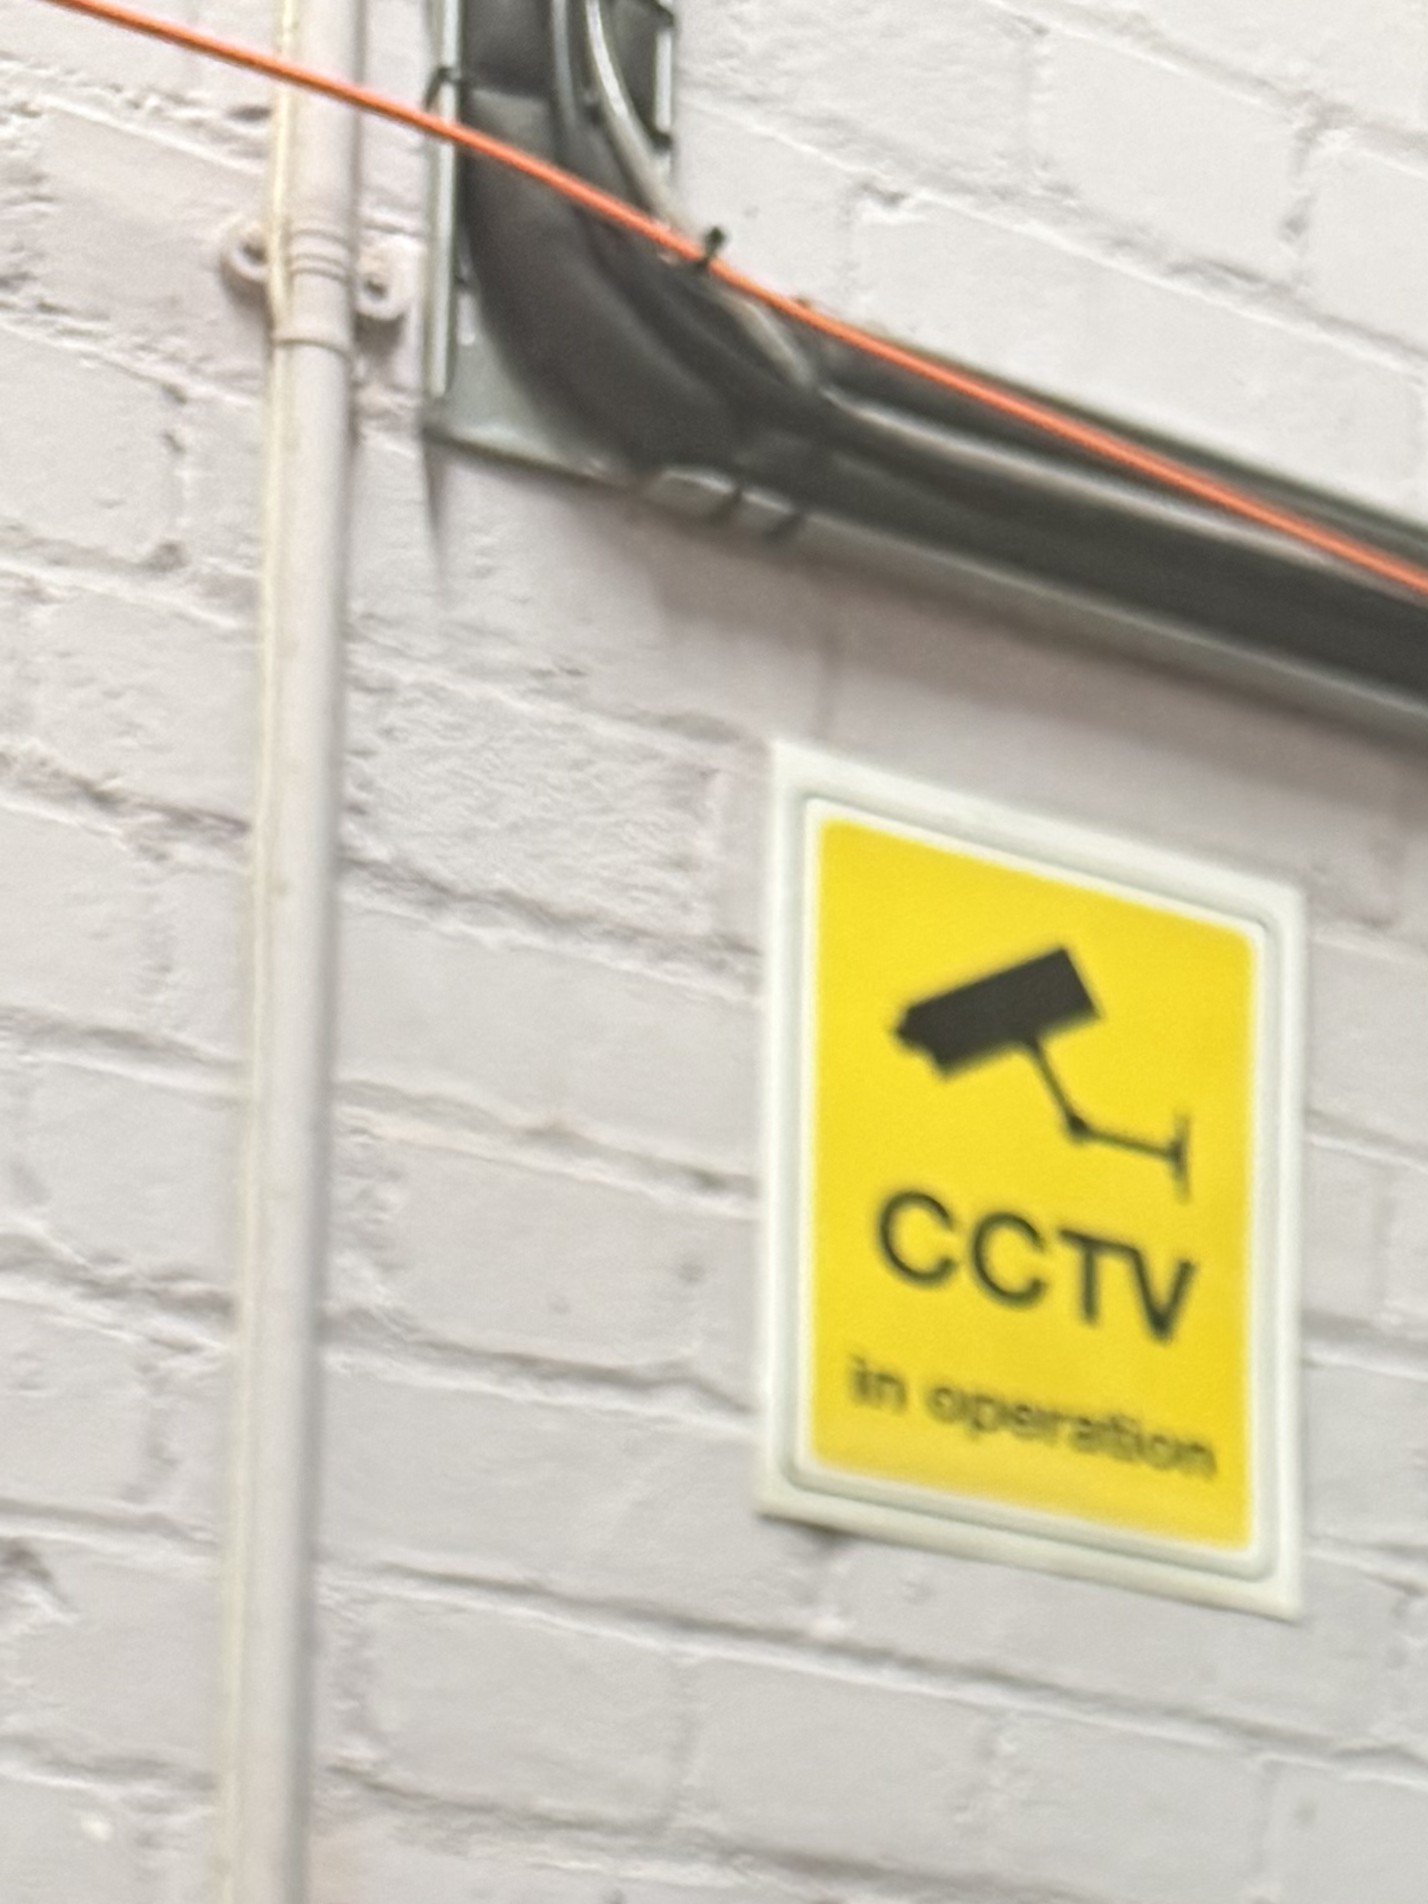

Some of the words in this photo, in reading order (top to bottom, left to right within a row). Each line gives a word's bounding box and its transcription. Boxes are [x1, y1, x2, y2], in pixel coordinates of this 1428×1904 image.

[877, 1188, 1195, 1344] CCTV
[850, 1352, 908, 1414] in
[926, 1383, 1217, 1482] operation
